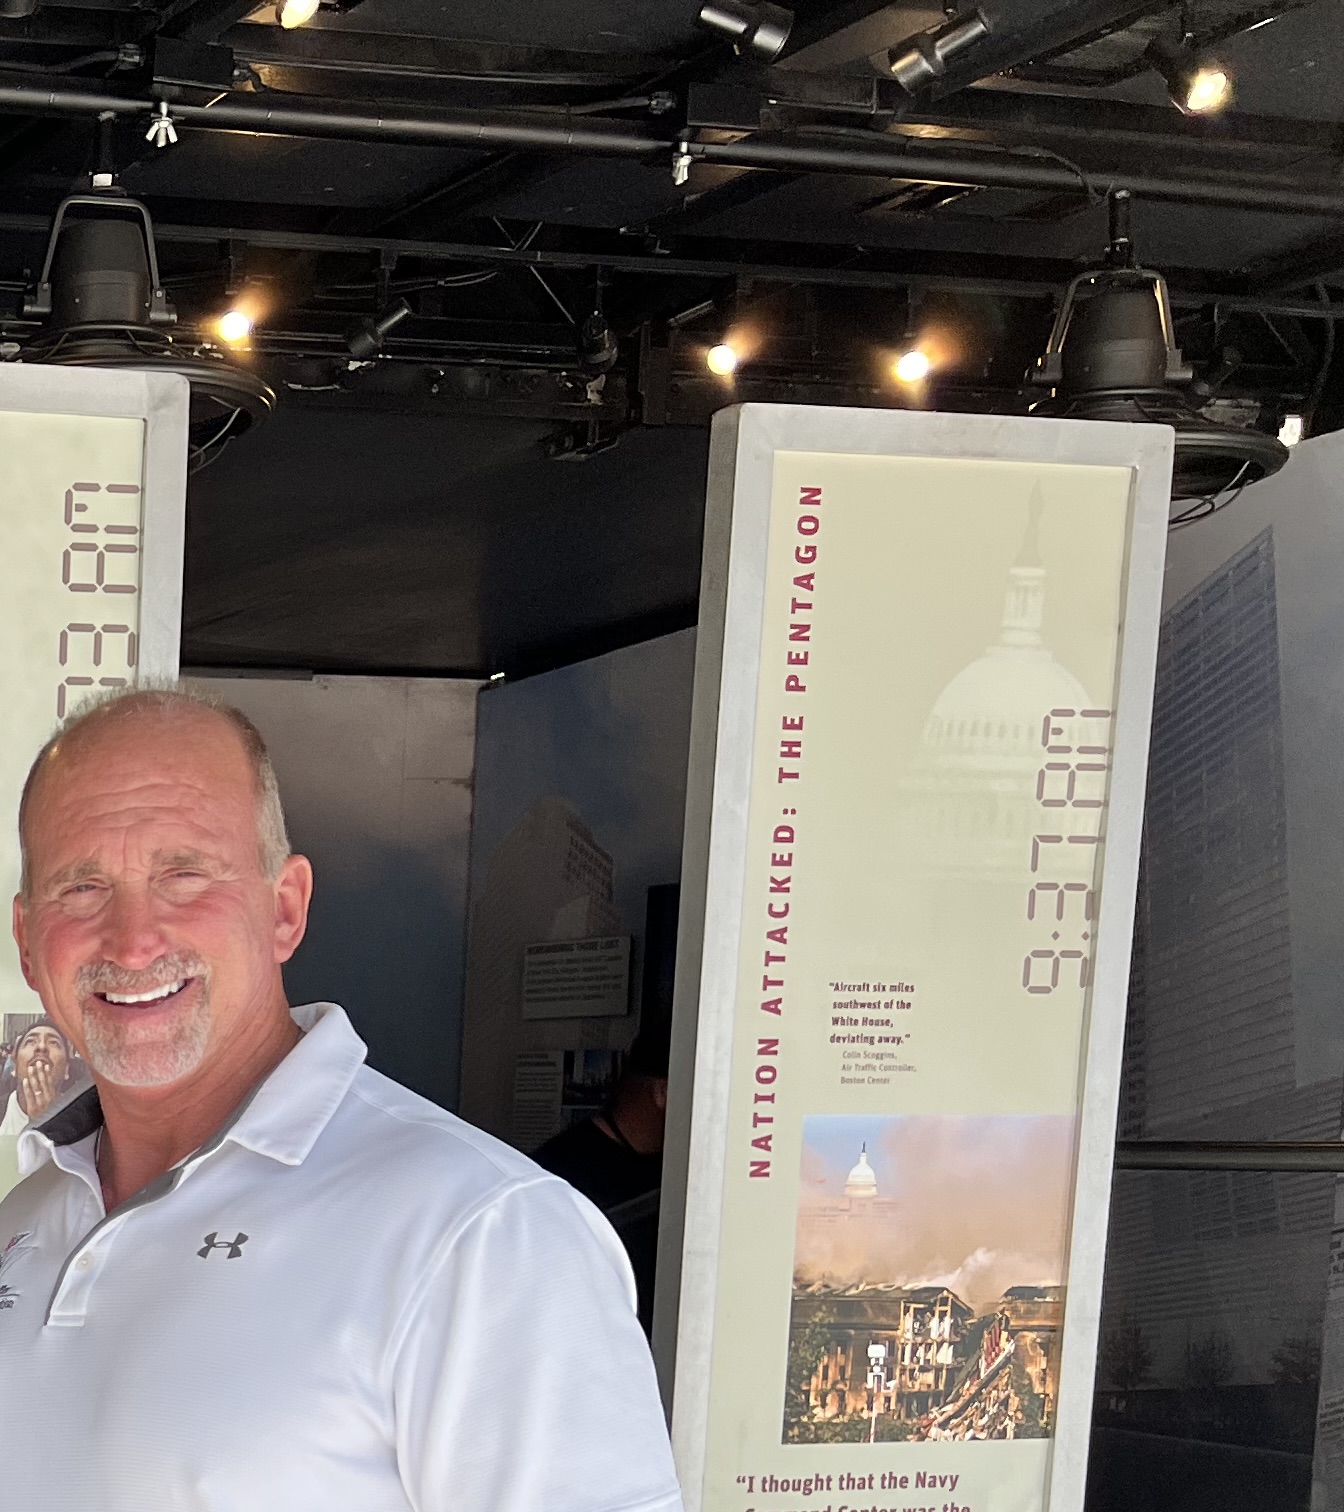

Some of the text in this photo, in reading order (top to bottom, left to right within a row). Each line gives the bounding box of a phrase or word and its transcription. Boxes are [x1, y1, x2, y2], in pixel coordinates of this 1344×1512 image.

[751, 487, 822, 1177] NATION ATTACKED: THE PENTAGON
[1022, 708, 1110, 994] 9:37 AM
[829, 982, 915, 993] "Aircraft six miles
[833, 999, 912, 1010] southwest of the
[831, 1016, 893, 1028] White House,
[829, 1033, 911, 1046] deviating away."
[736, 1471, 959, 1495] "I thought that the Navy
